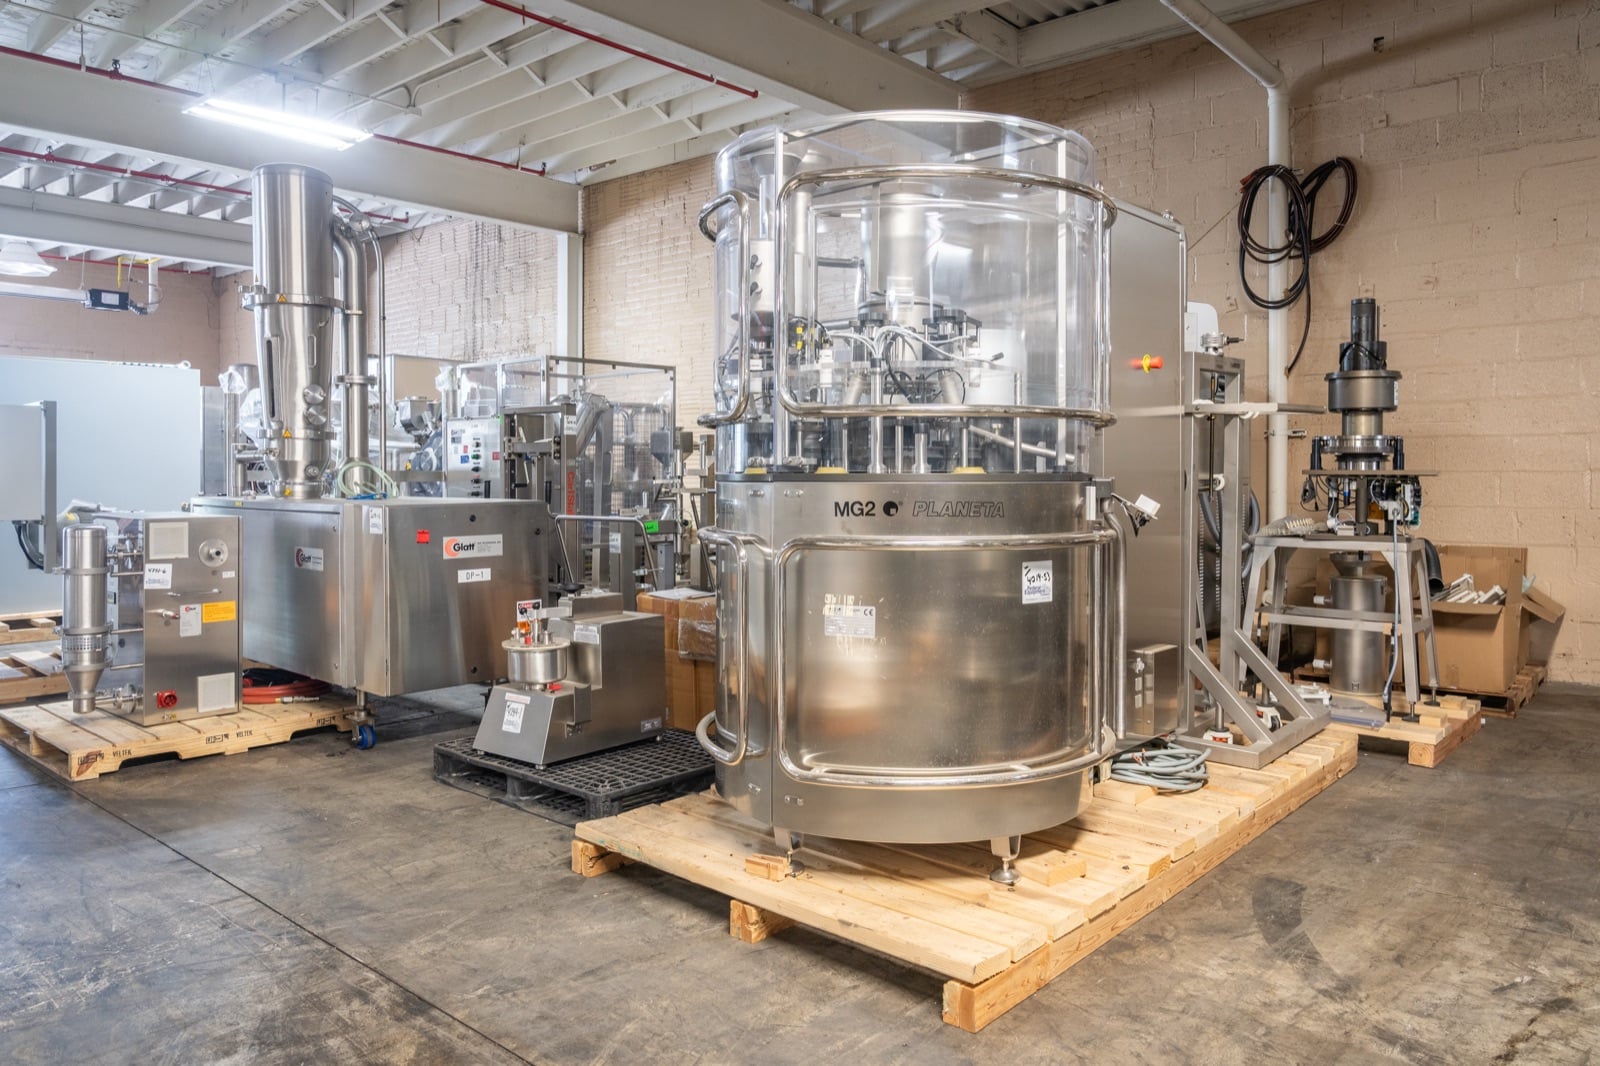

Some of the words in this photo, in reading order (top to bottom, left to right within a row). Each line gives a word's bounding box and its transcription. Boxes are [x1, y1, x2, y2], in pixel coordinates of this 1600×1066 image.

[834, 500, 876, 518] MG2
[912, 500, 1005, 518] PLANETA
[453, 542, 475, 552] Glatt
[465, 570, 484, 581] DP-1
